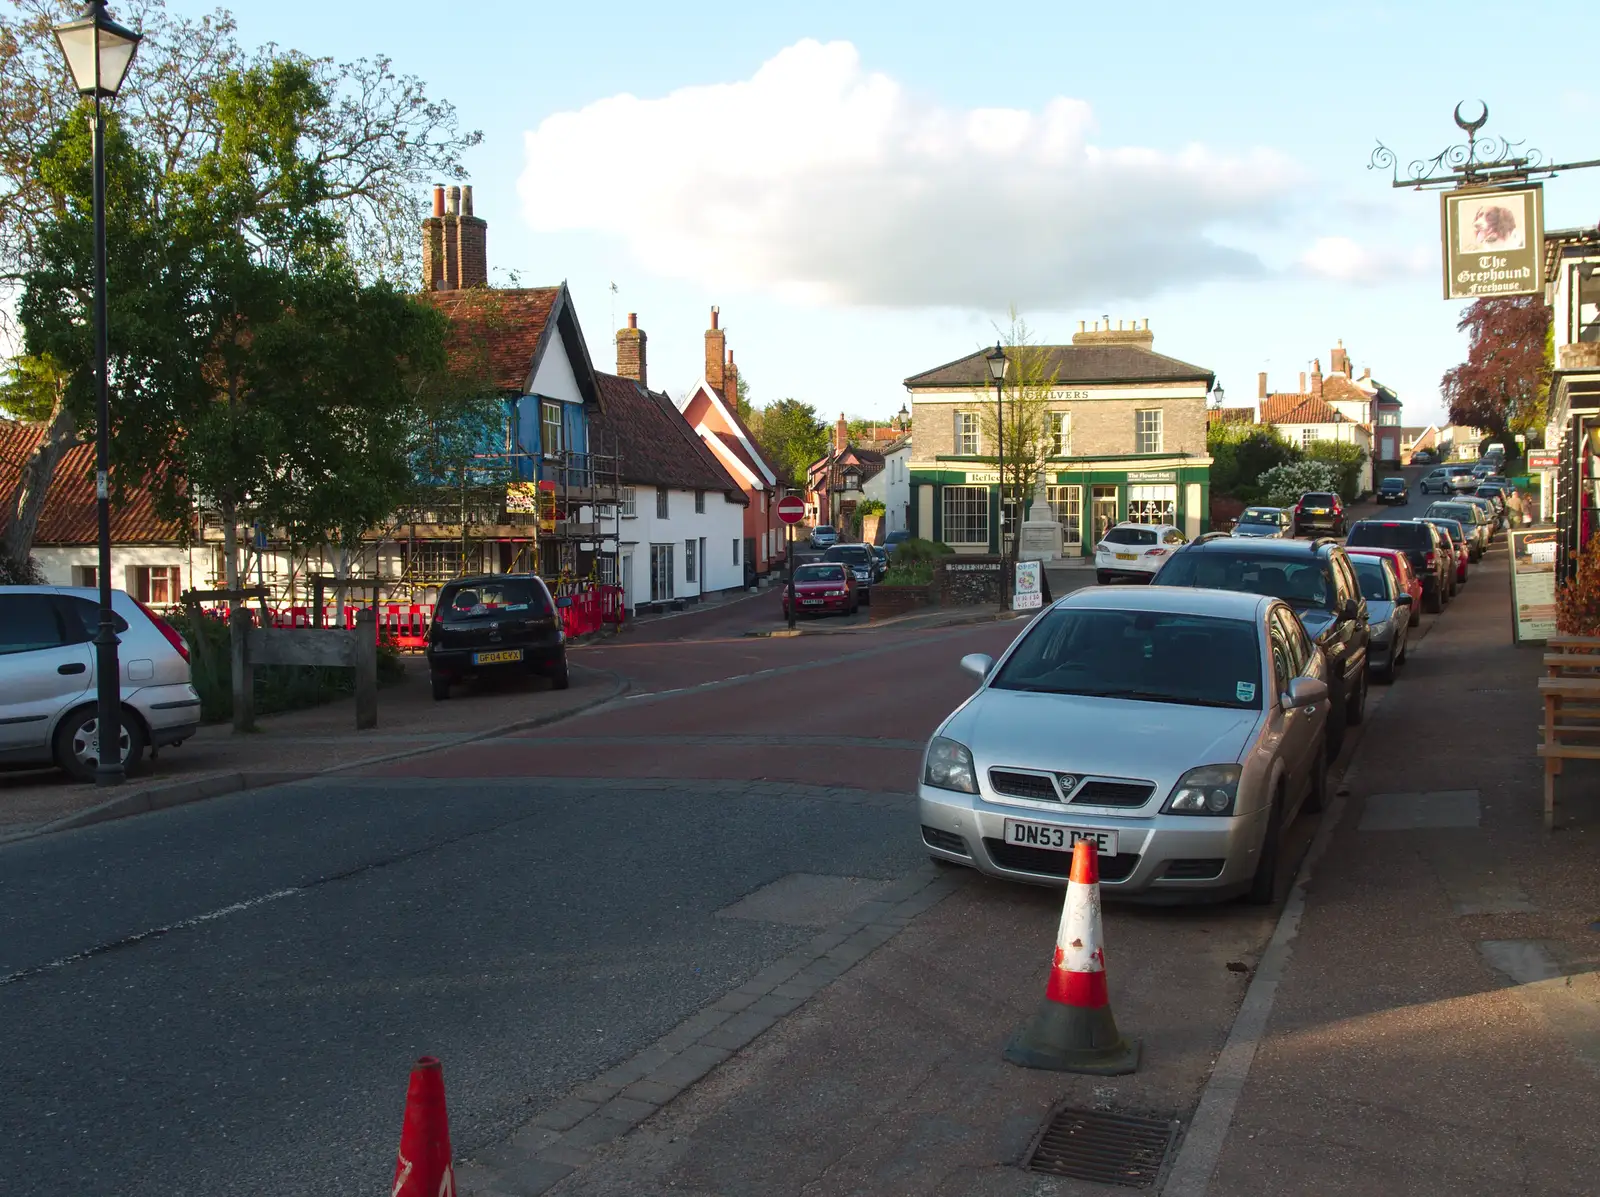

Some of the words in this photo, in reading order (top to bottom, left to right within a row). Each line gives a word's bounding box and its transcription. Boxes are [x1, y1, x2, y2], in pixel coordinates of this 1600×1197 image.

[1478, 256, 1507, 268] The
[1457, 266, 1530, 283] Greyhound
[1468, 282, 1520, 293] Freehouse
[1026, 391, 1089, 399] CHILVERS
[480, 652, 500, 662] GF04
[1014, 823, 1064, 848] DN53
